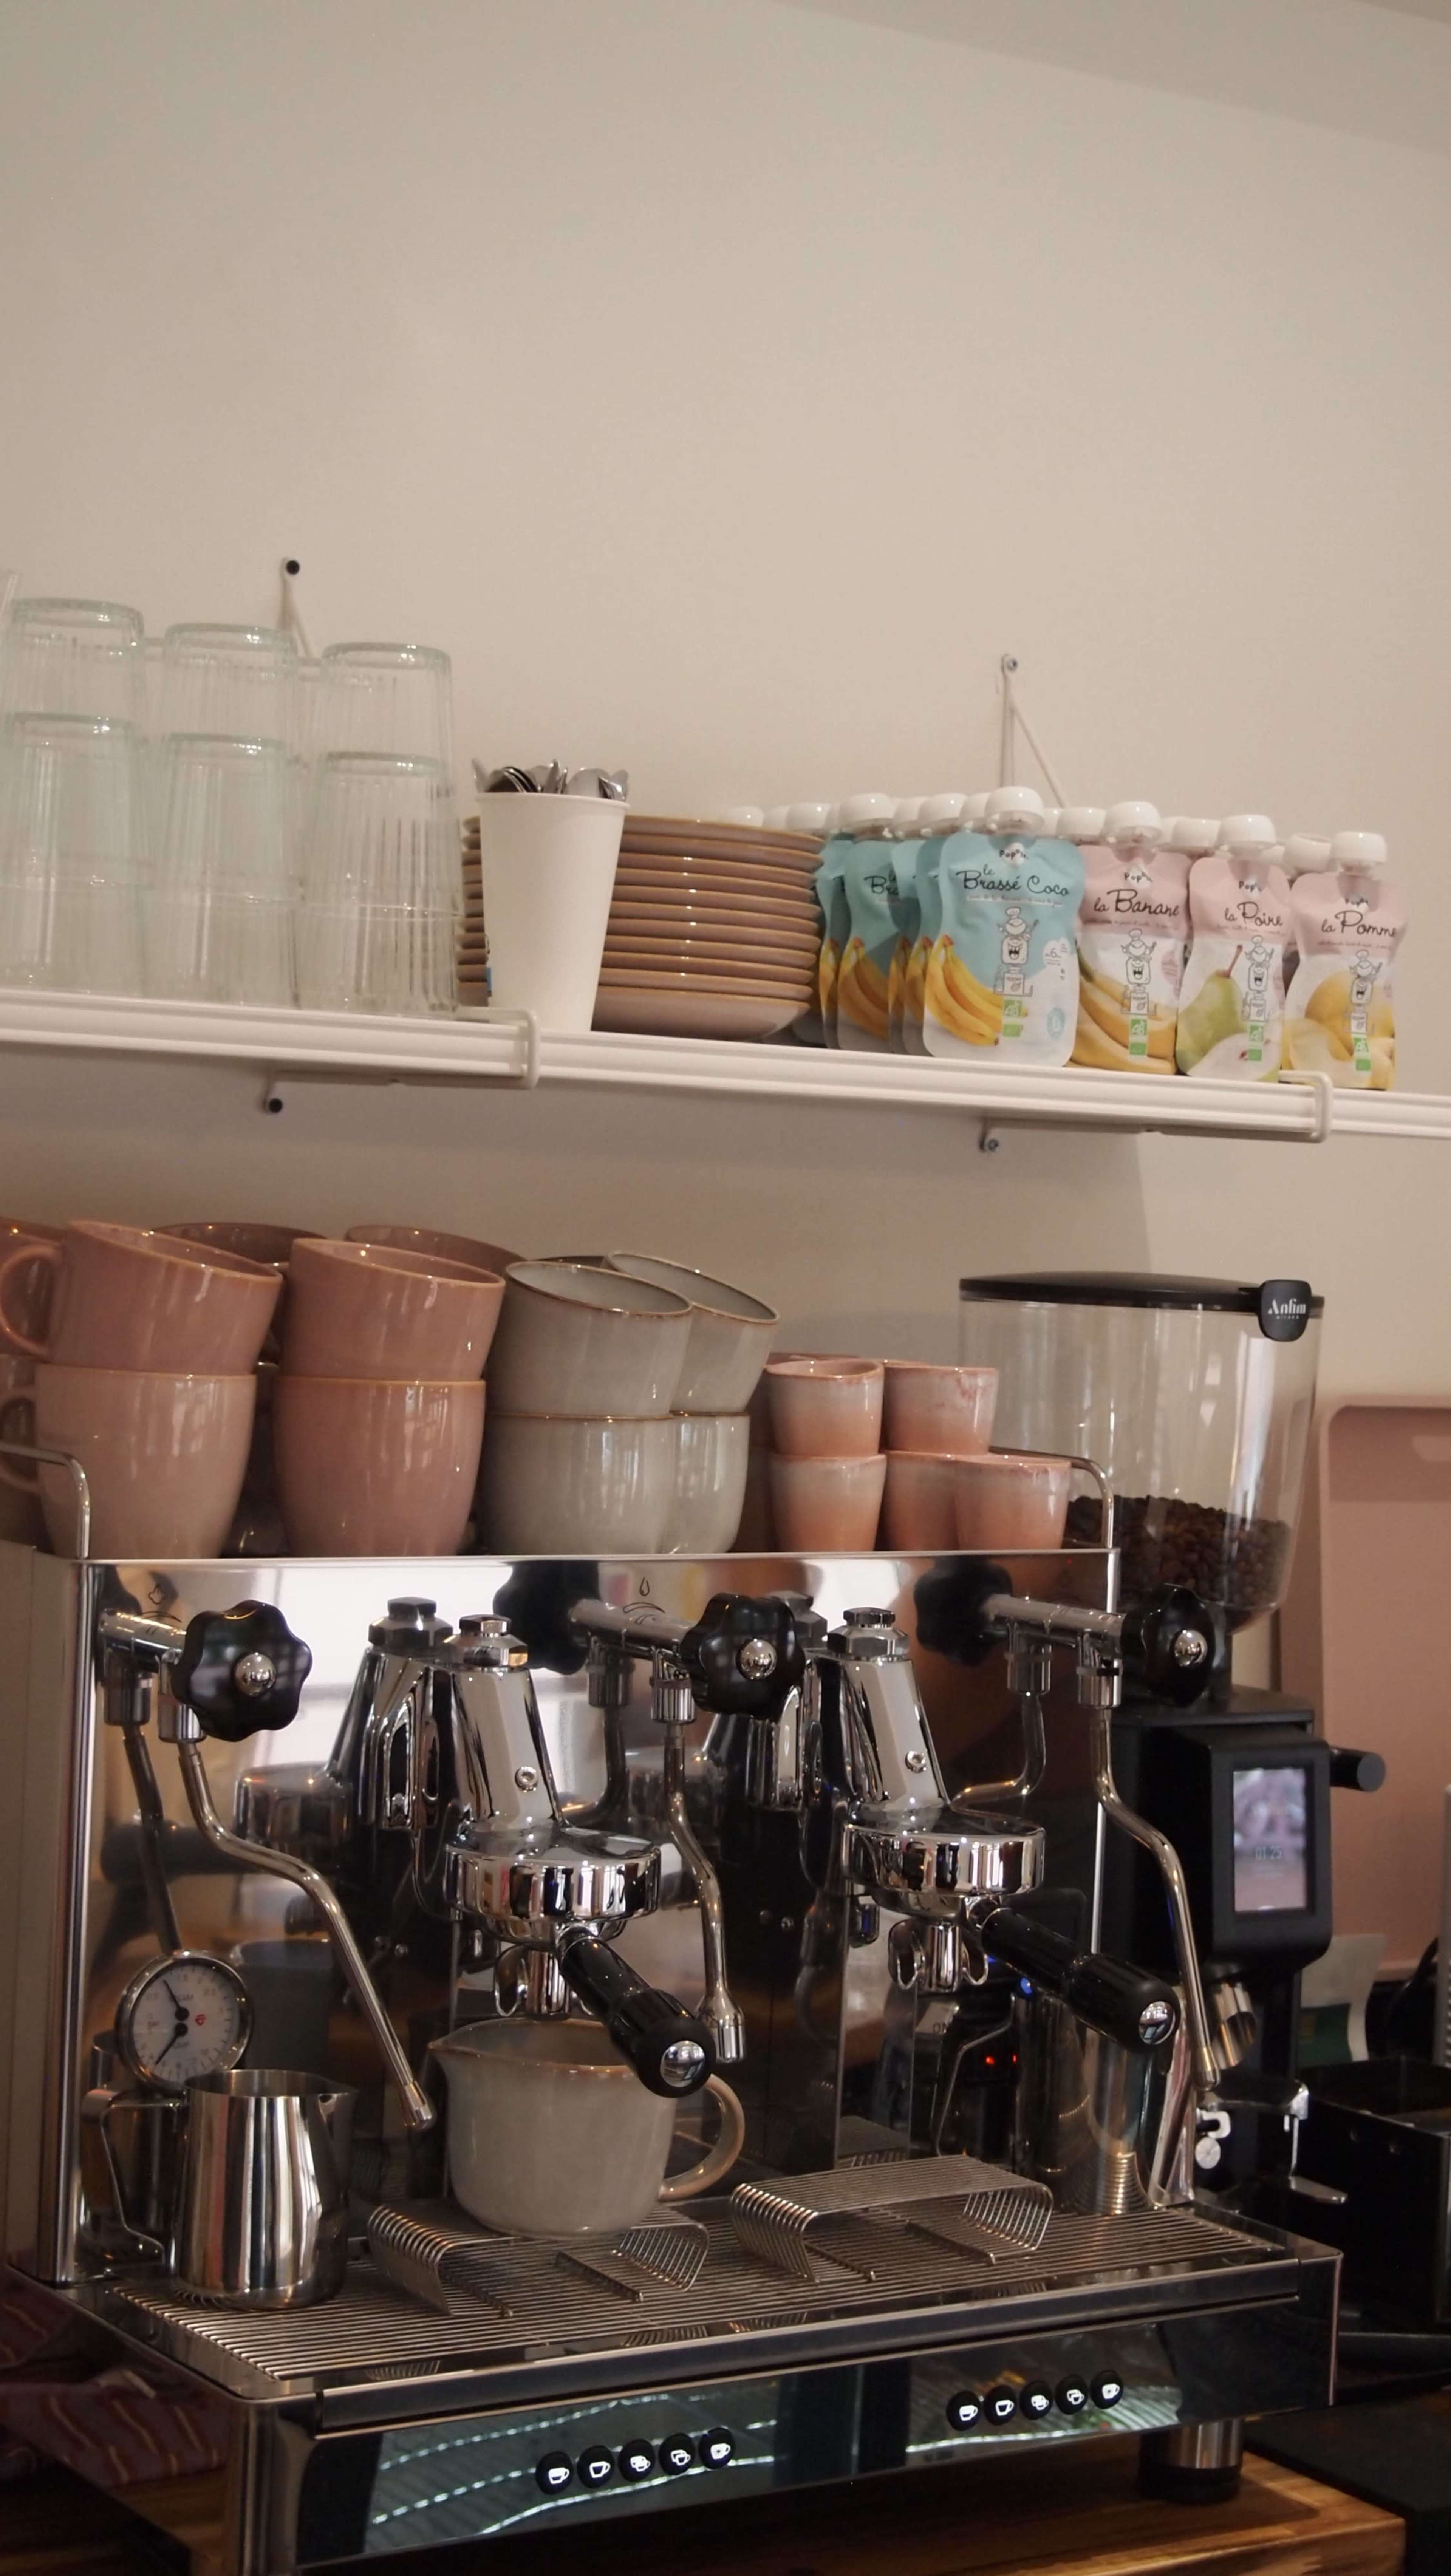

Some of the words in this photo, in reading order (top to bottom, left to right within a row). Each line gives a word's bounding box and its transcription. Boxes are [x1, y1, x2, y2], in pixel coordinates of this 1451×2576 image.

[983, 864, 995, 875] le
[956, 870, 1021, 891] Brassé
[1027, 875, 1069, 896] Coco
[1094, 897, 1109, 912] la
[1107, 889, 1179, 917] Banane
[1225, 908, 1238, 922] la
[1237, 901, 1284, 926] Poire
[1321, 918, 1336, 933] la
[1268, 1298, 1306, 1314] Anfim
